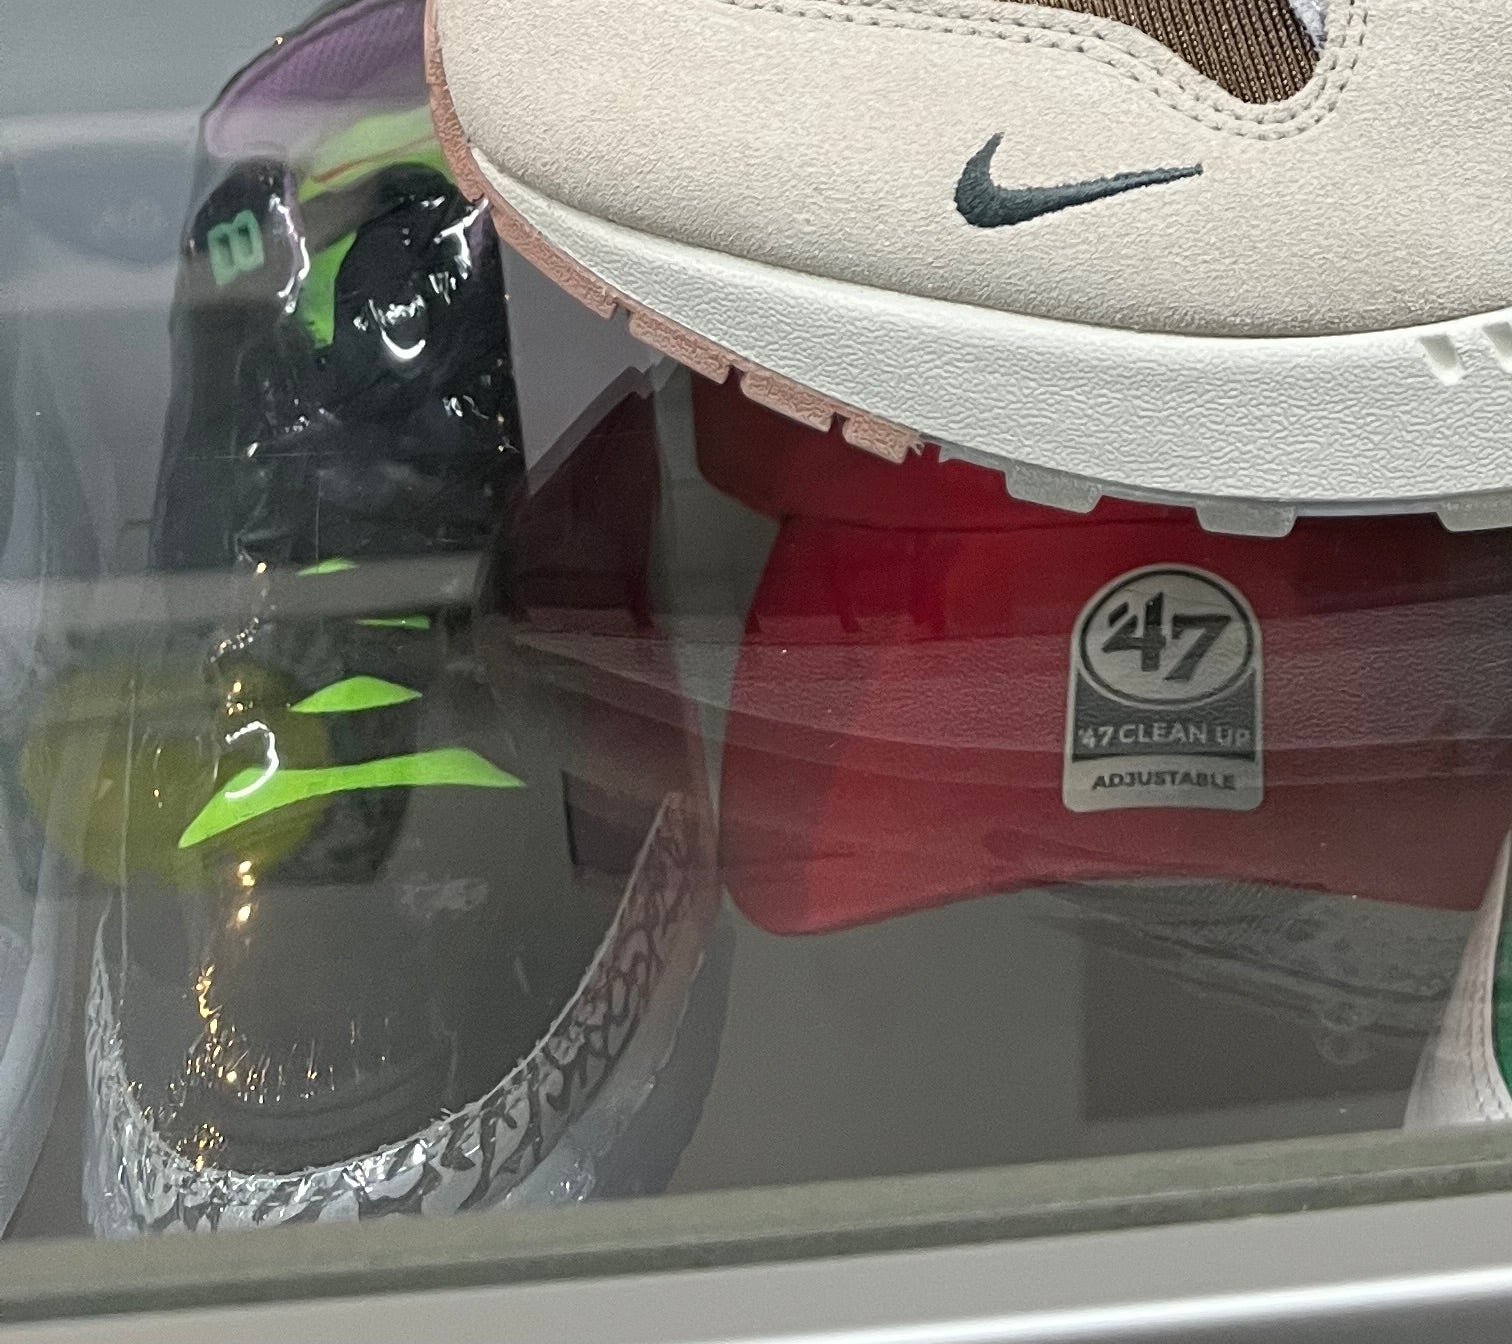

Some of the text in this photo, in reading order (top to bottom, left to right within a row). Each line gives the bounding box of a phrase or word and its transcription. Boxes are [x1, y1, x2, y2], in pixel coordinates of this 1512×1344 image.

[1119, 721, 1207, 745] CLEAN
[1215, 726, 1250, 747] UP
[1092, 770, 1236, 791] ADJUSTABLE
